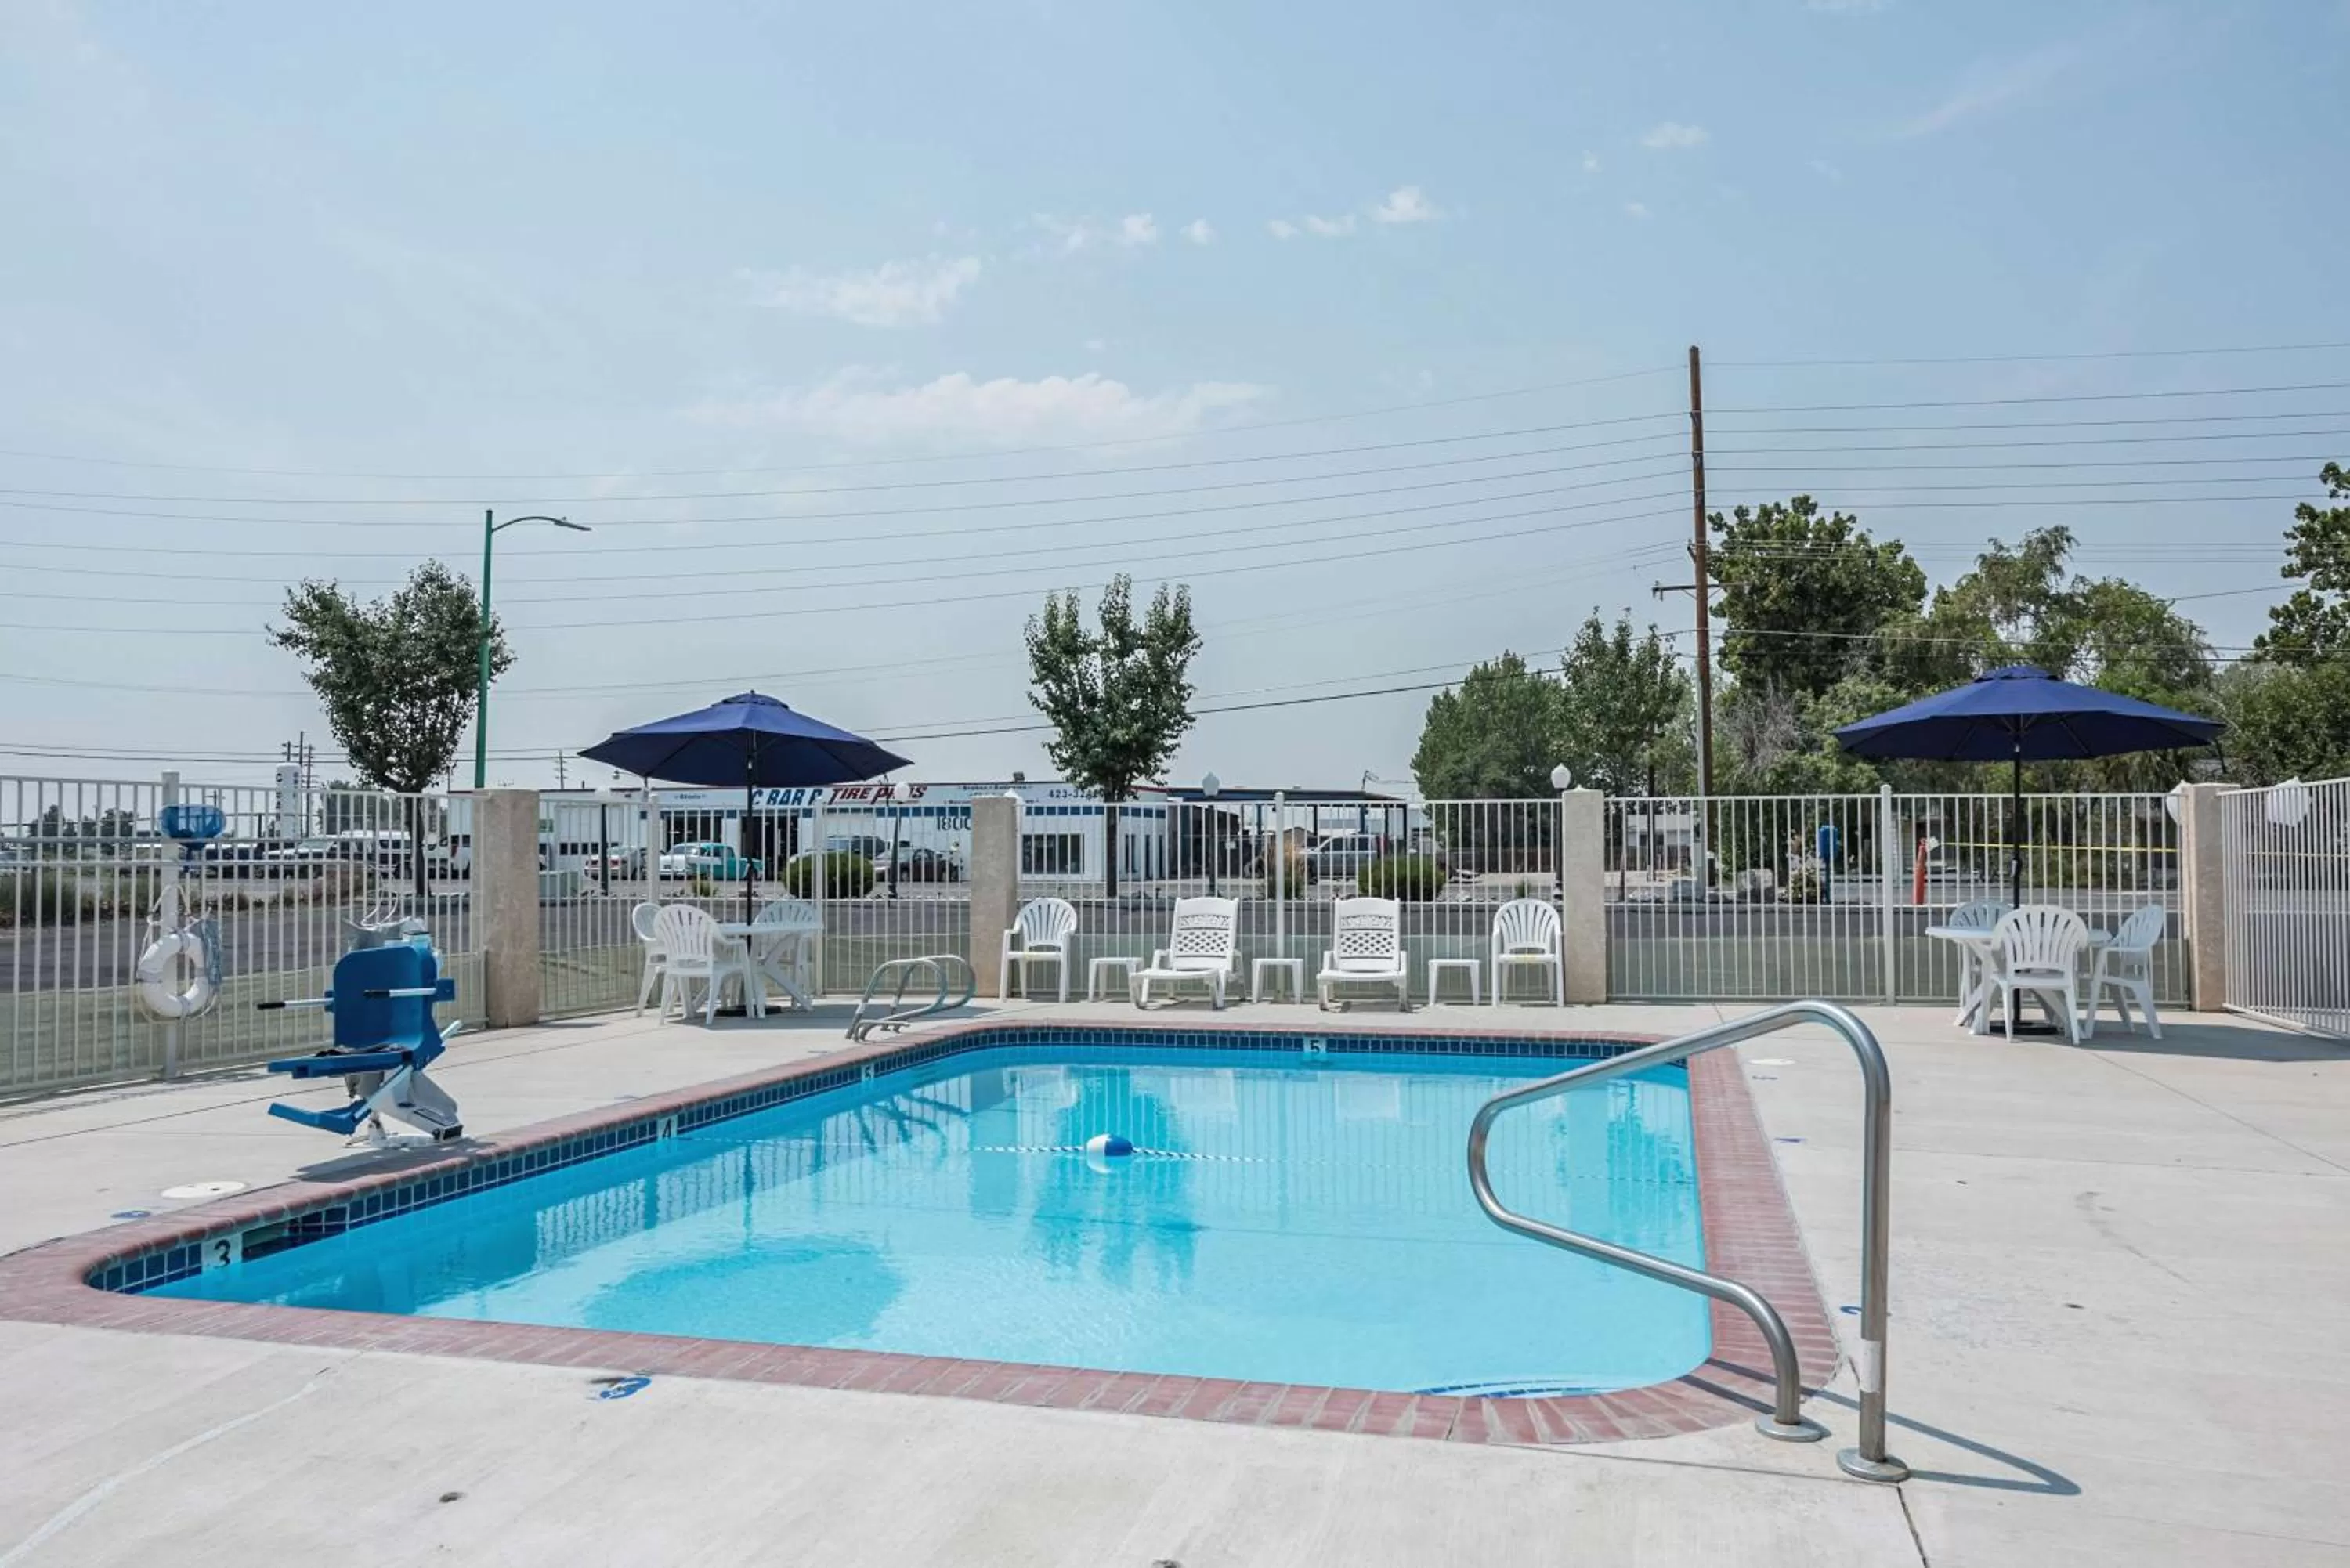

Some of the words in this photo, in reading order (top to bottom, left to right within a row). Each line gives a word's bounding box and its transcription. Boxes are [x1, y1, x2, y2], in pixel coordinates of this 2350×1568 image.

[767, 789, 806, 805] BAR
[827, 787, 873, 805] TIRE
[1309, 1039, 1320, 1054] 5
[662, 1118, 671, 1140] 4
[213, 1238, 231, 1268] 3
